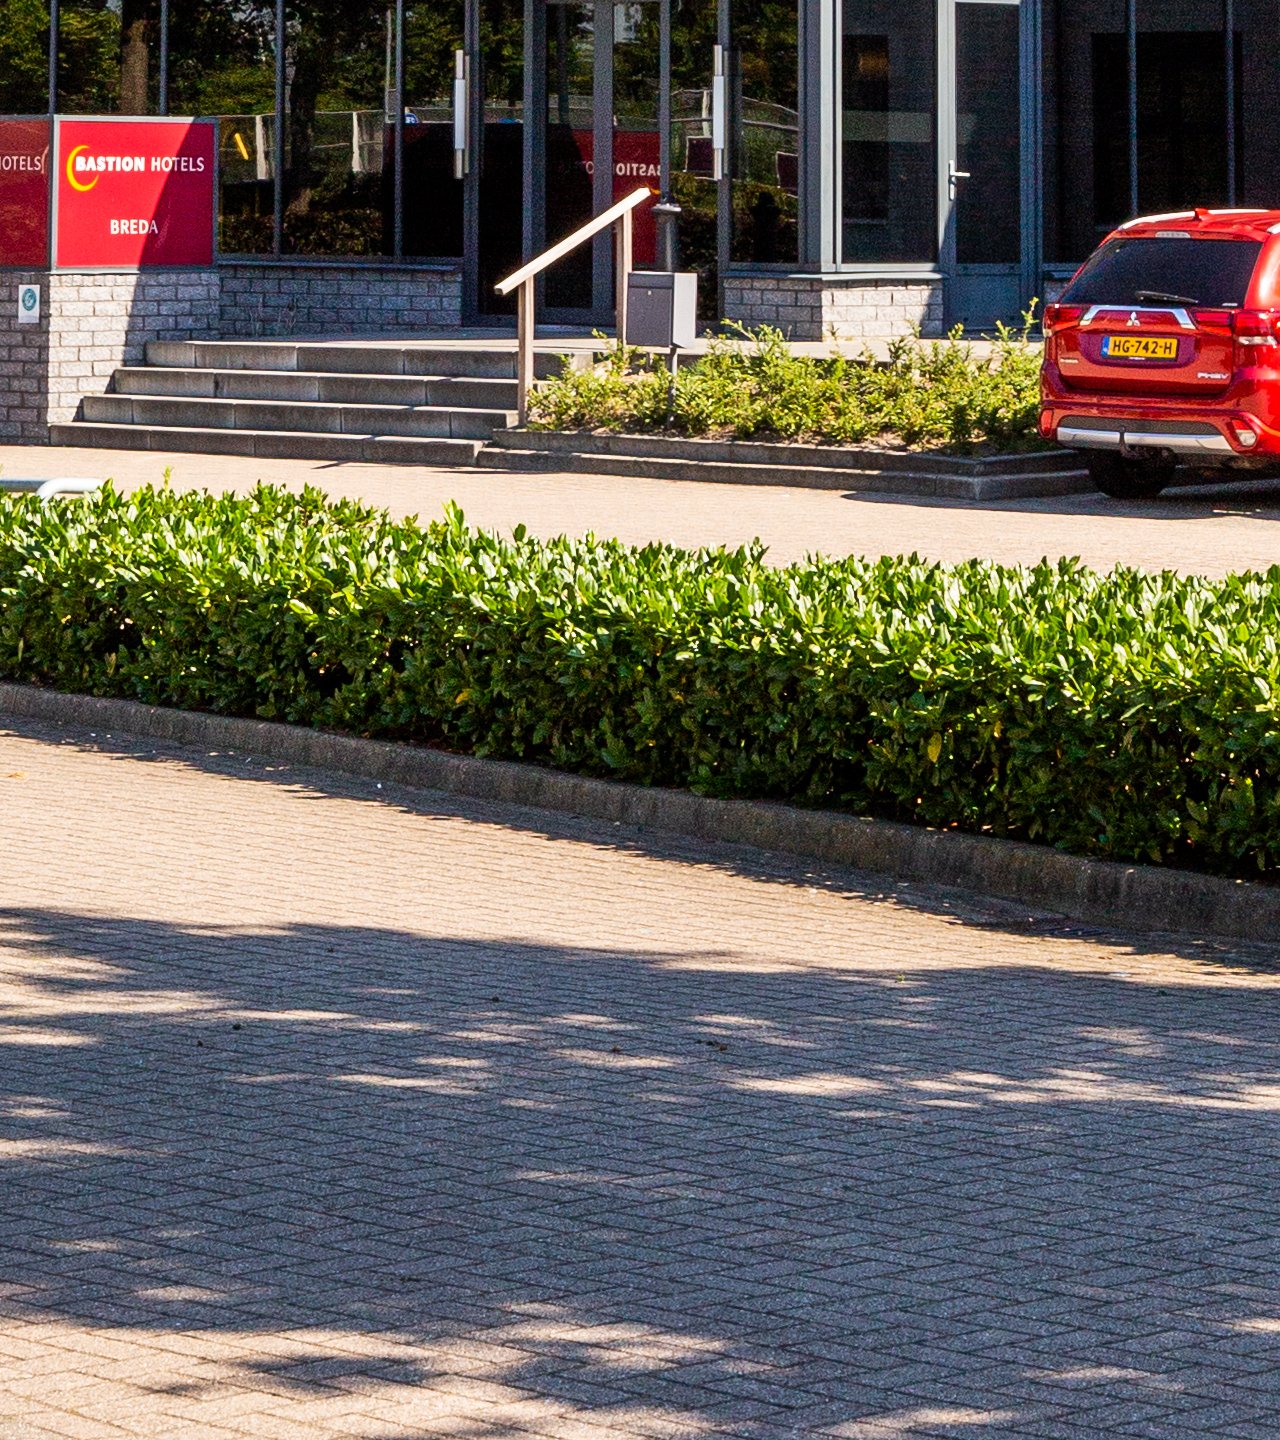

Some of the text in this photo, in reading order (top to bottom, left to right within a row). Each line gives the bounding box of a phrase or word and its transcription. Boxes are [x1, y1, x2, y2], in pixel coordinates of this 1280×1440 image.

[75, 156, 205, 172] BASTION HOTELS
[110, 219, 159, 235] BREDA
[1112, 339, 1172, 355] HG-742-H
